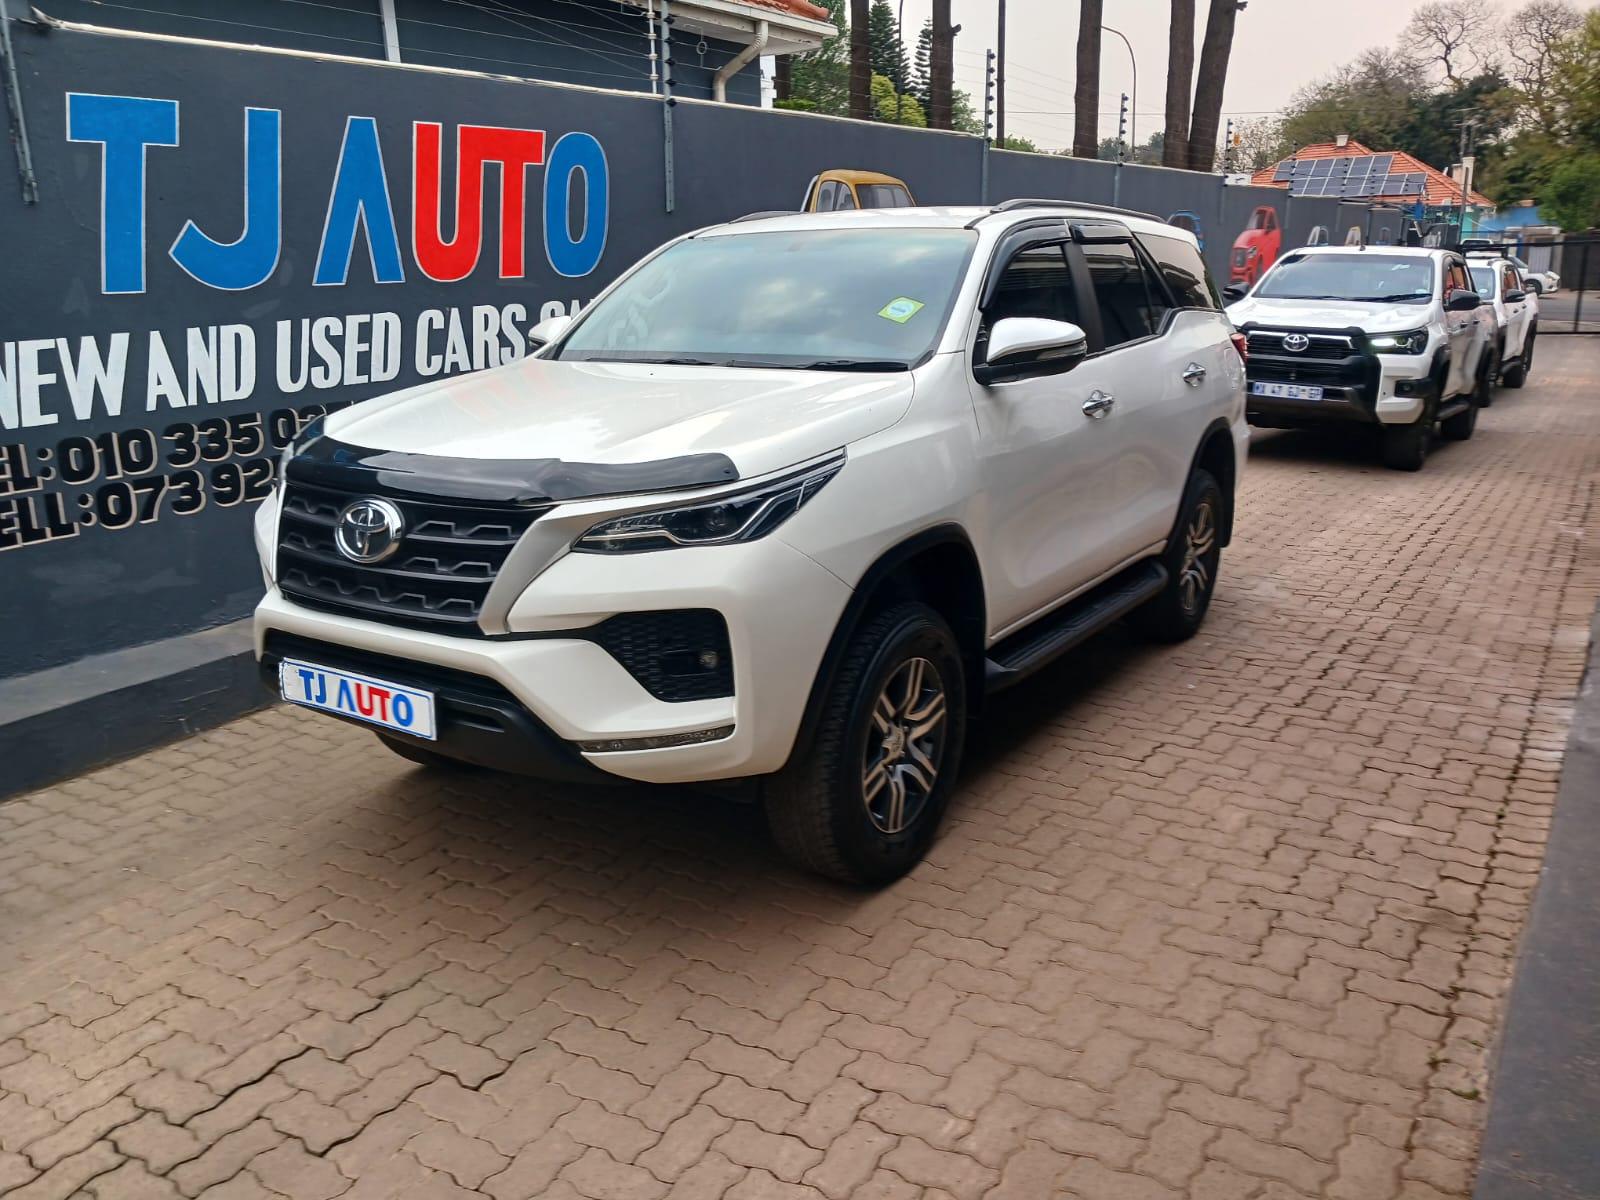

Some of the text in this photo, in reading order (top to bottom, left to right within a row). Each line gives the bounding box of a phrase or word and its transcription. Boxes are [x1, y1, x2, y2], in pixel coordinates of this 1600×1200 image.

[66, 92, 610, 294] TJ AUTO
[0, 303, 527, 429] NEW AND USED CARS
[163, 412, 264, 468] 335
[298, 668, 414, 727] TJ AUTO
